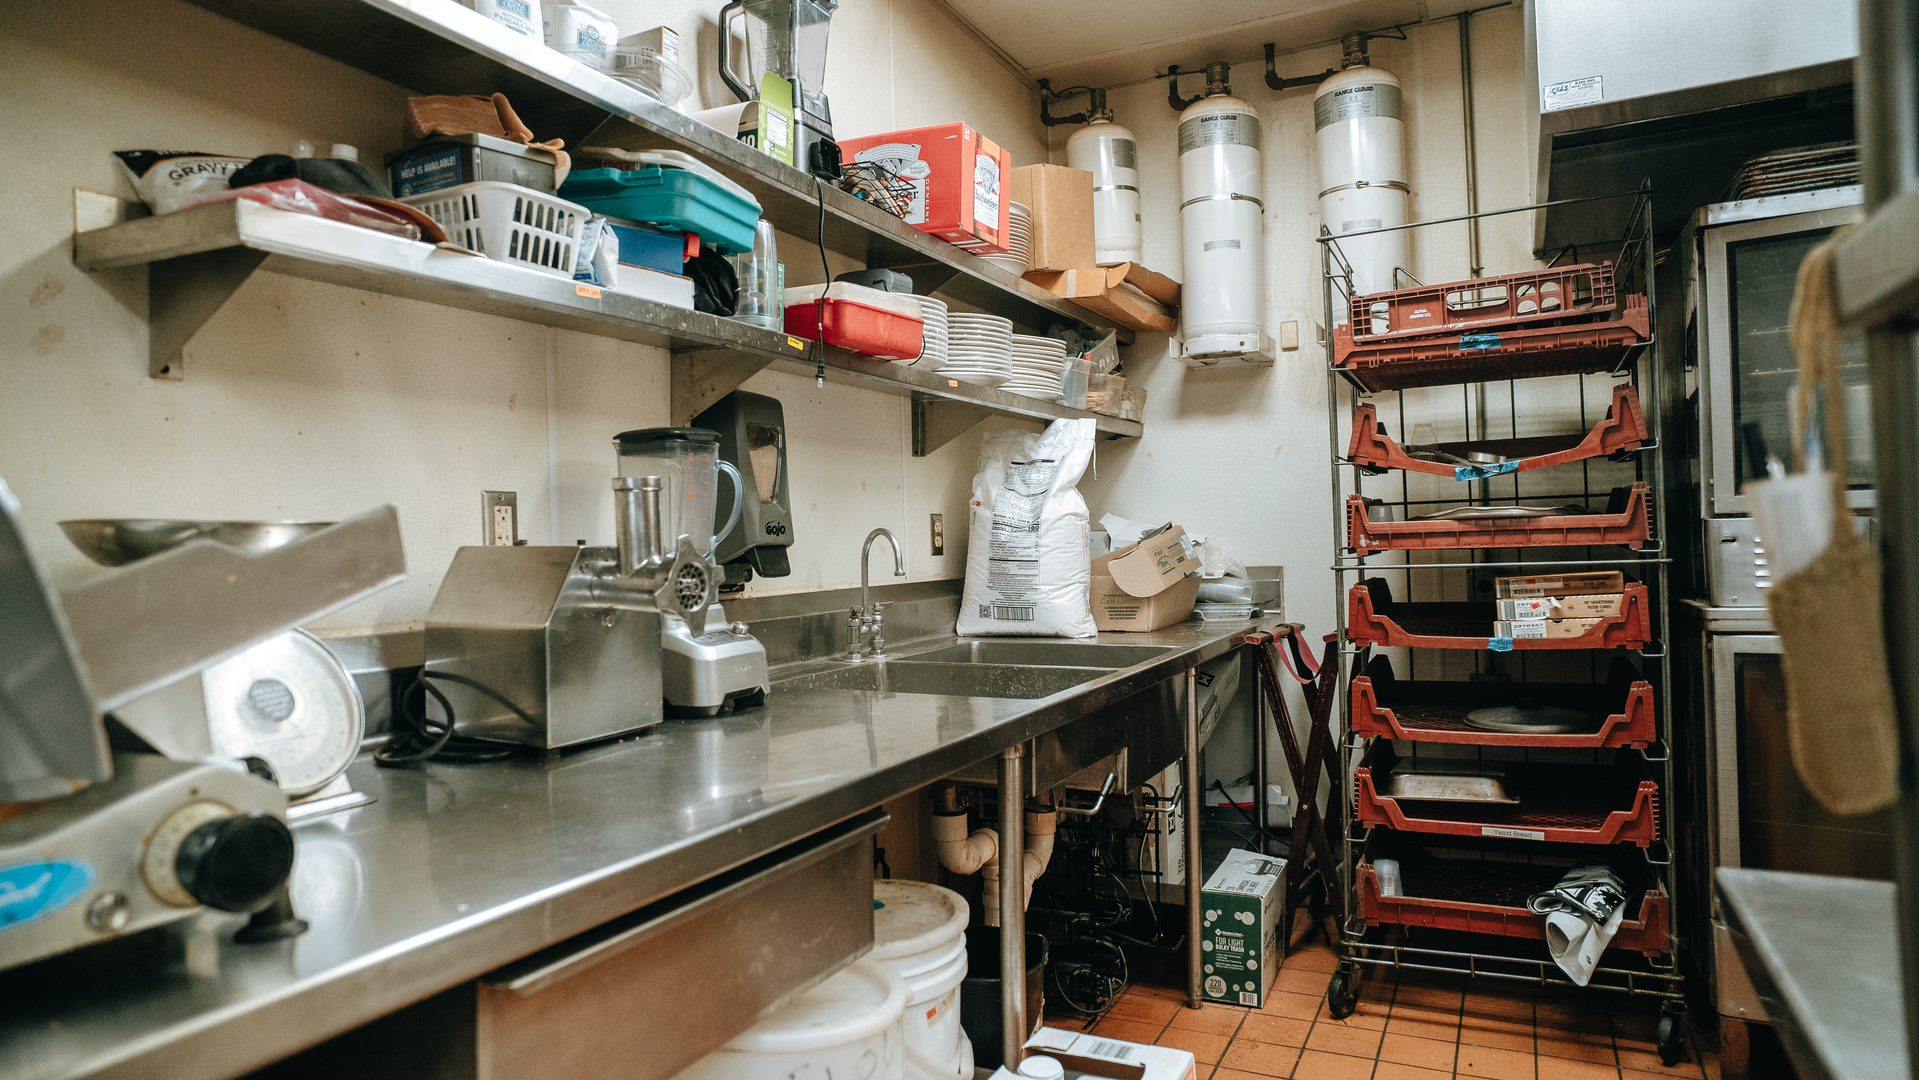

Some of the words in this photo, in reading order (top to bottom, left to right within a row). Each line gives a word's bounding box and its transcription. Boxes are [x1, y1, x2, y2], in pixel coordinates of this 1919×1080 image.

[1334, 87, 1353, 98] RANGE
[1353, 85, 1374, 93] GUARD
[1200, 115, 1219, 124] RANGE
[168, 162, 227, 181] GRAVY
[401, 166, 416, 179] HELP
[416, 164, 424, 175] IS
[424, 155, 457, 173] AVAILABLE!
[975, 188, 999, 211] Budweiser
[1493, 829, 1512, 837] Yeast
[1513, 831, 1533, 839] Bread
[1215, 936, 1227, 945] FOR
[1227, 937, 1245, 947] LIGHT
[1215, 943, 1230, 951] BULKY
[1230, 945, 1245, 953] TRASH
[1209, 978, 1222, 988] 220
